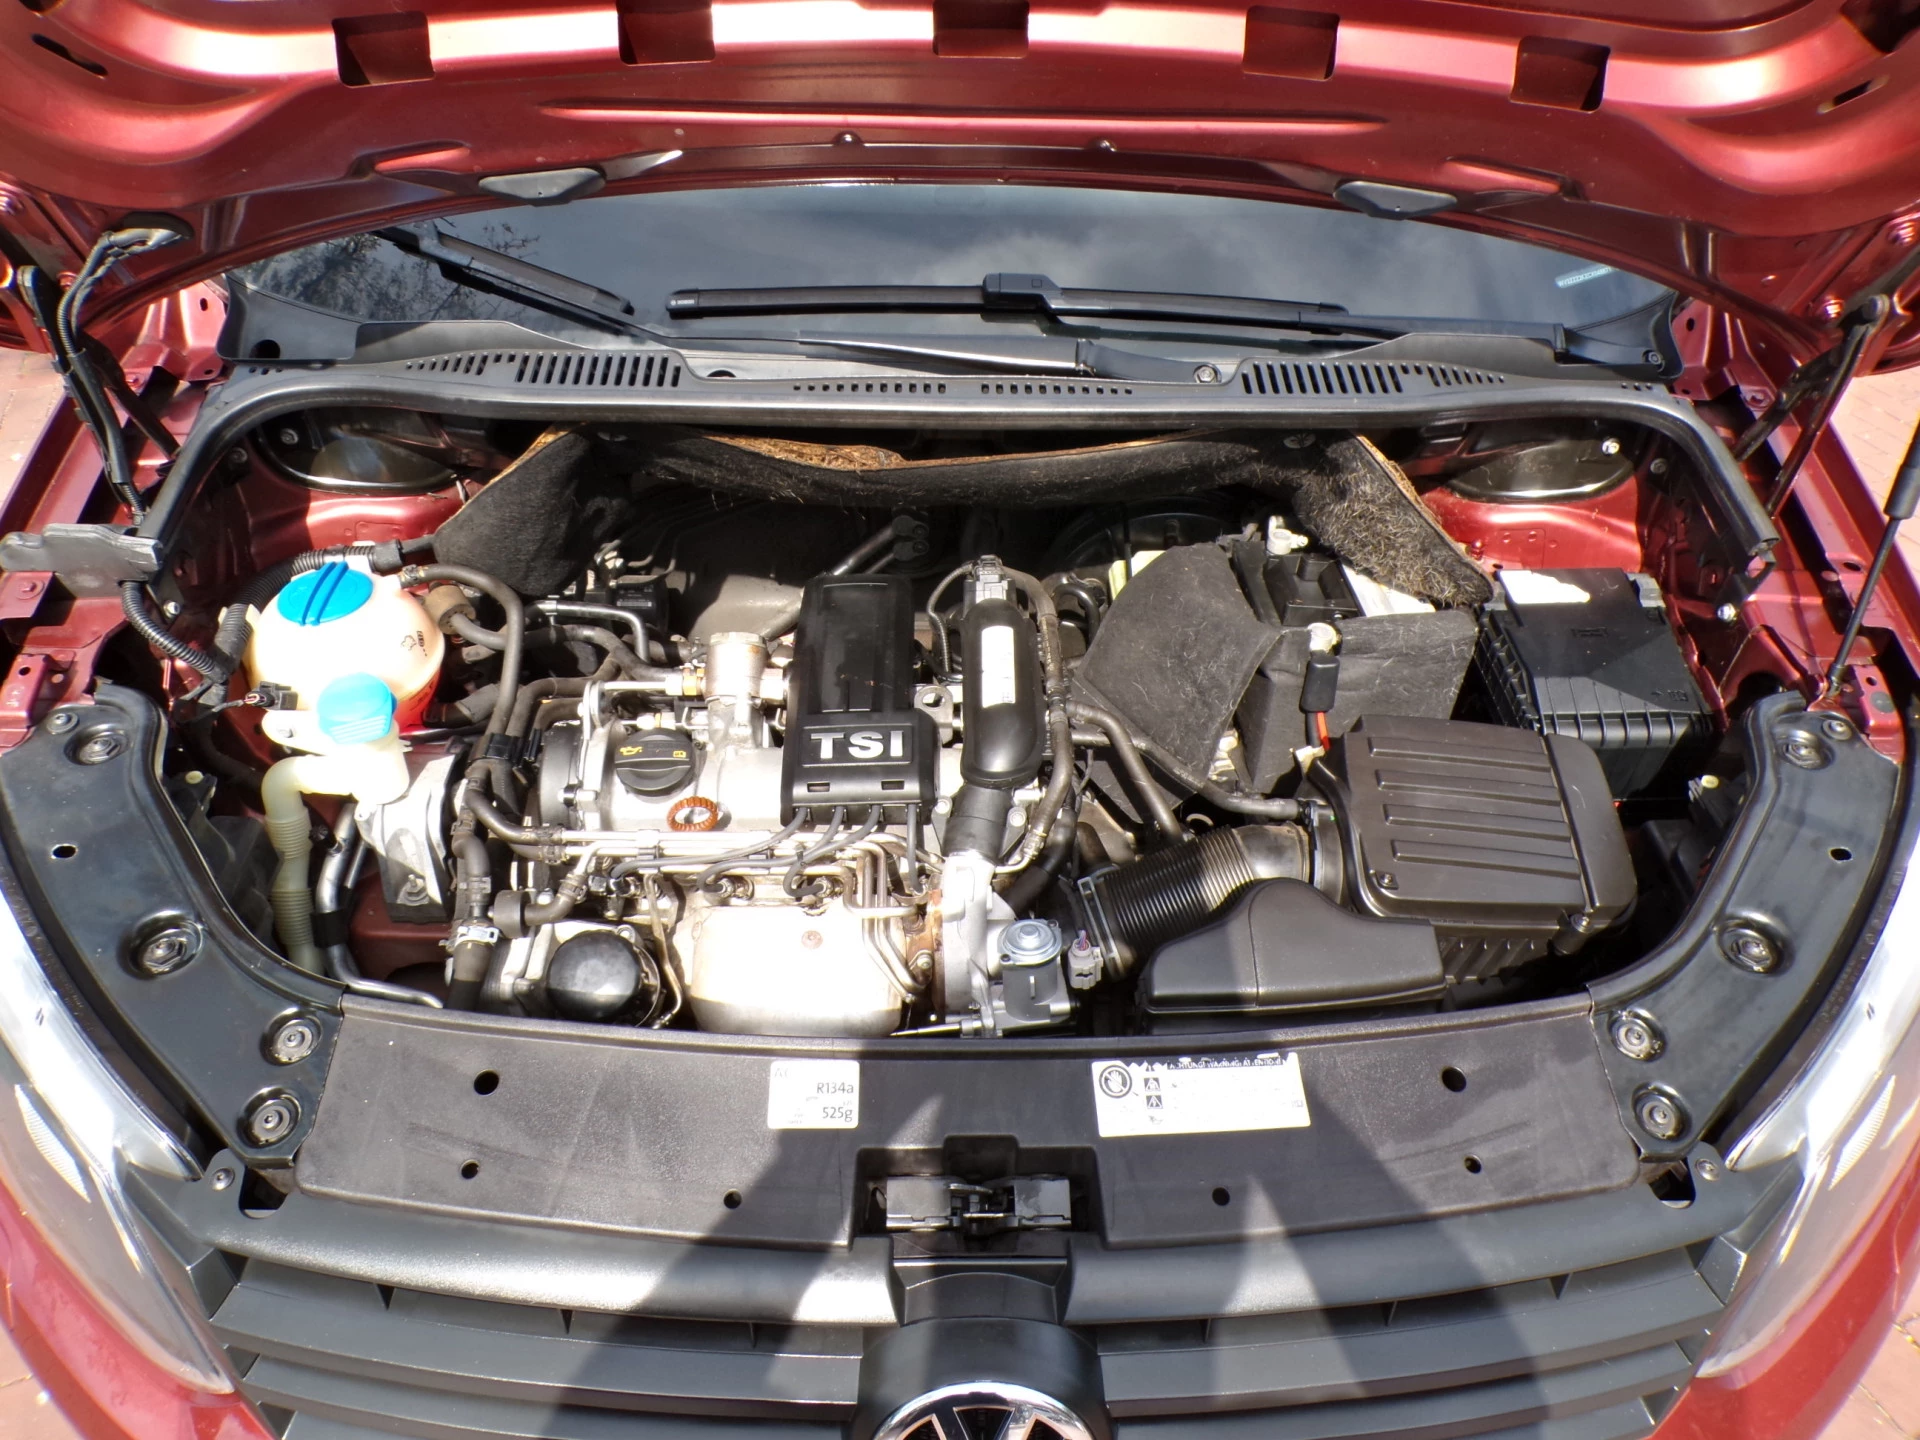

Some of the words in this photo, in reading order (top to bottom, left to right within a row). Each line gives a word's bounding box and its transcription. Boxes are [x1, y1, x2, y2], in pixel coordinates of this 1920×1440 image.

[810, 730, 903, 759] TSI
[816, 1081, 854, 1094] R134a
[822, 1106, 853, 1122] 525g
